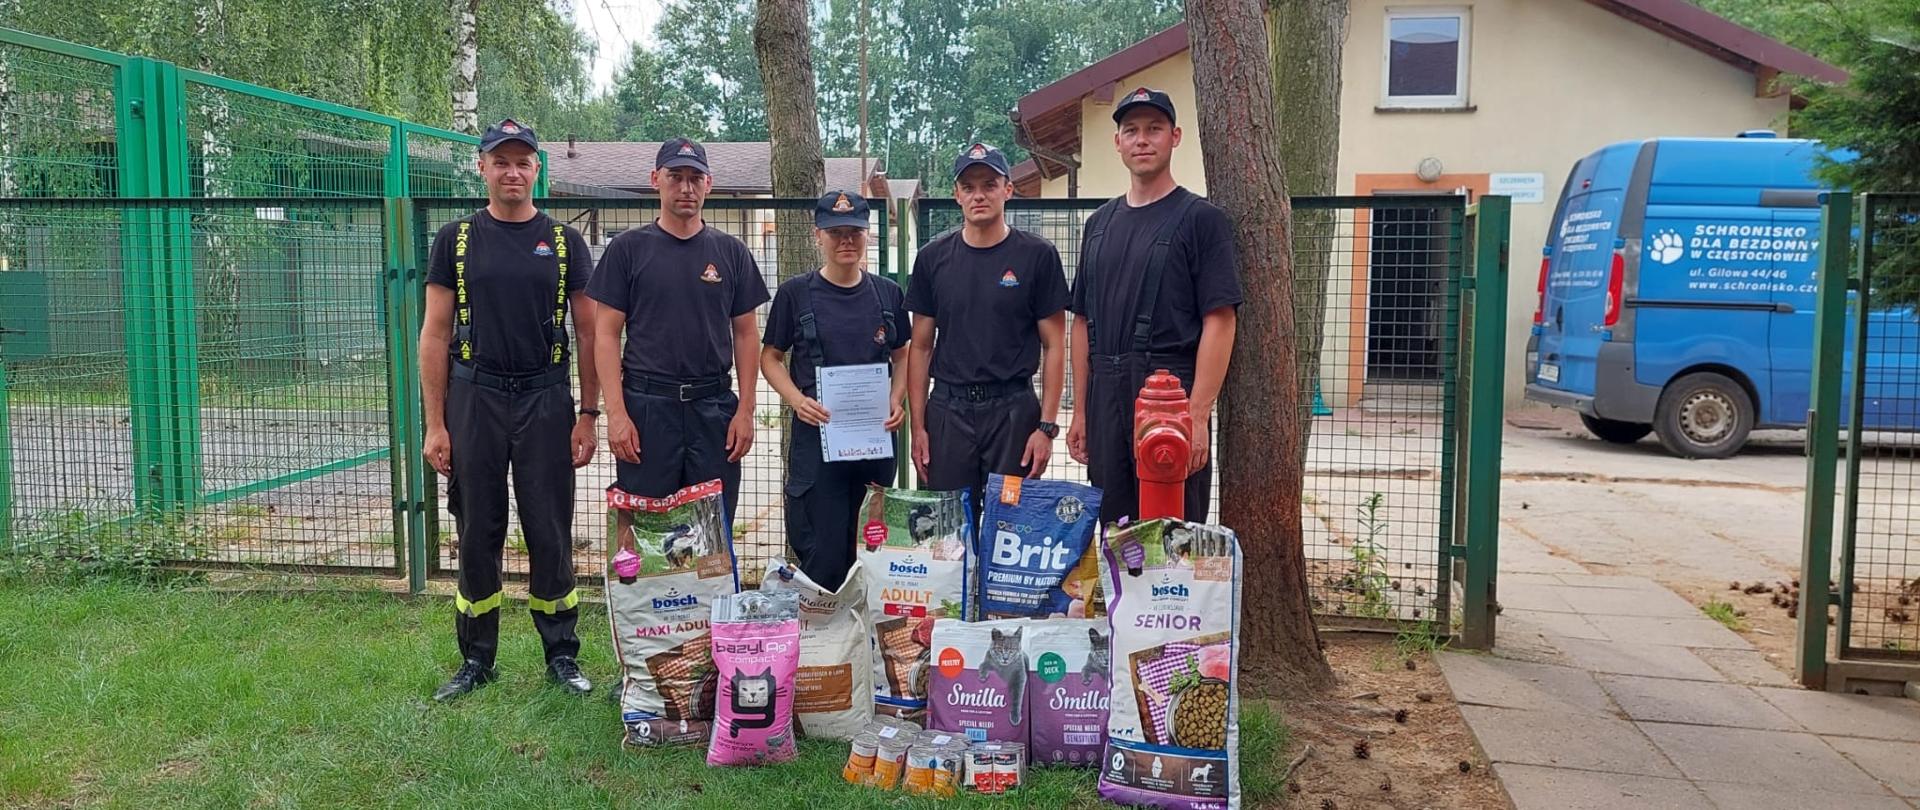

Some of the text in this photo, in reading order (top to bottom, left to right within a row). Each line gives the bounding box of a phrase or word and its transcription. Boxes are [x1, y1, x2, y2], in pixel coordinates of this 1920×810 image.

[1695, 225, 1807, 238] SCHRONISKO
[1690, 238, 1820, 251] DLA BEZDOMNY
[1690, 250, 1809, 262] W CZĘSTOCHOWIE
[1689, 268, 1788, 280] ul. Gilowa 44/46
[629, 496, 648, 510] kg
[992, 530, 1070, 570] Brit
[889, 561, 928, 574] bosch
[988, 571, 1022, 585] PREMIUM
[1023, 575, 1034, 585] BY
[880, 587, 933, 604] ADULT
[1151, 583, 1190, 597] bosch
[651, 593, 698, 608] bosch
[636, 619, 712, 638] MAXI ADUL
[1134, 613, 1203, 632] SENIOR
[715, 640, 765, 655] bazyl
[729, 654, 777, 665] compact
[947, 683, 1007, 708] Smilla
[1050, 687, 1109, 711] Smilla
[958, 719, 995, 729] SPECIAL NEEDS
[1063, 724, 1101, 732] SPECIAL NEEDS
[1208, 802, 1221, 810] KG
